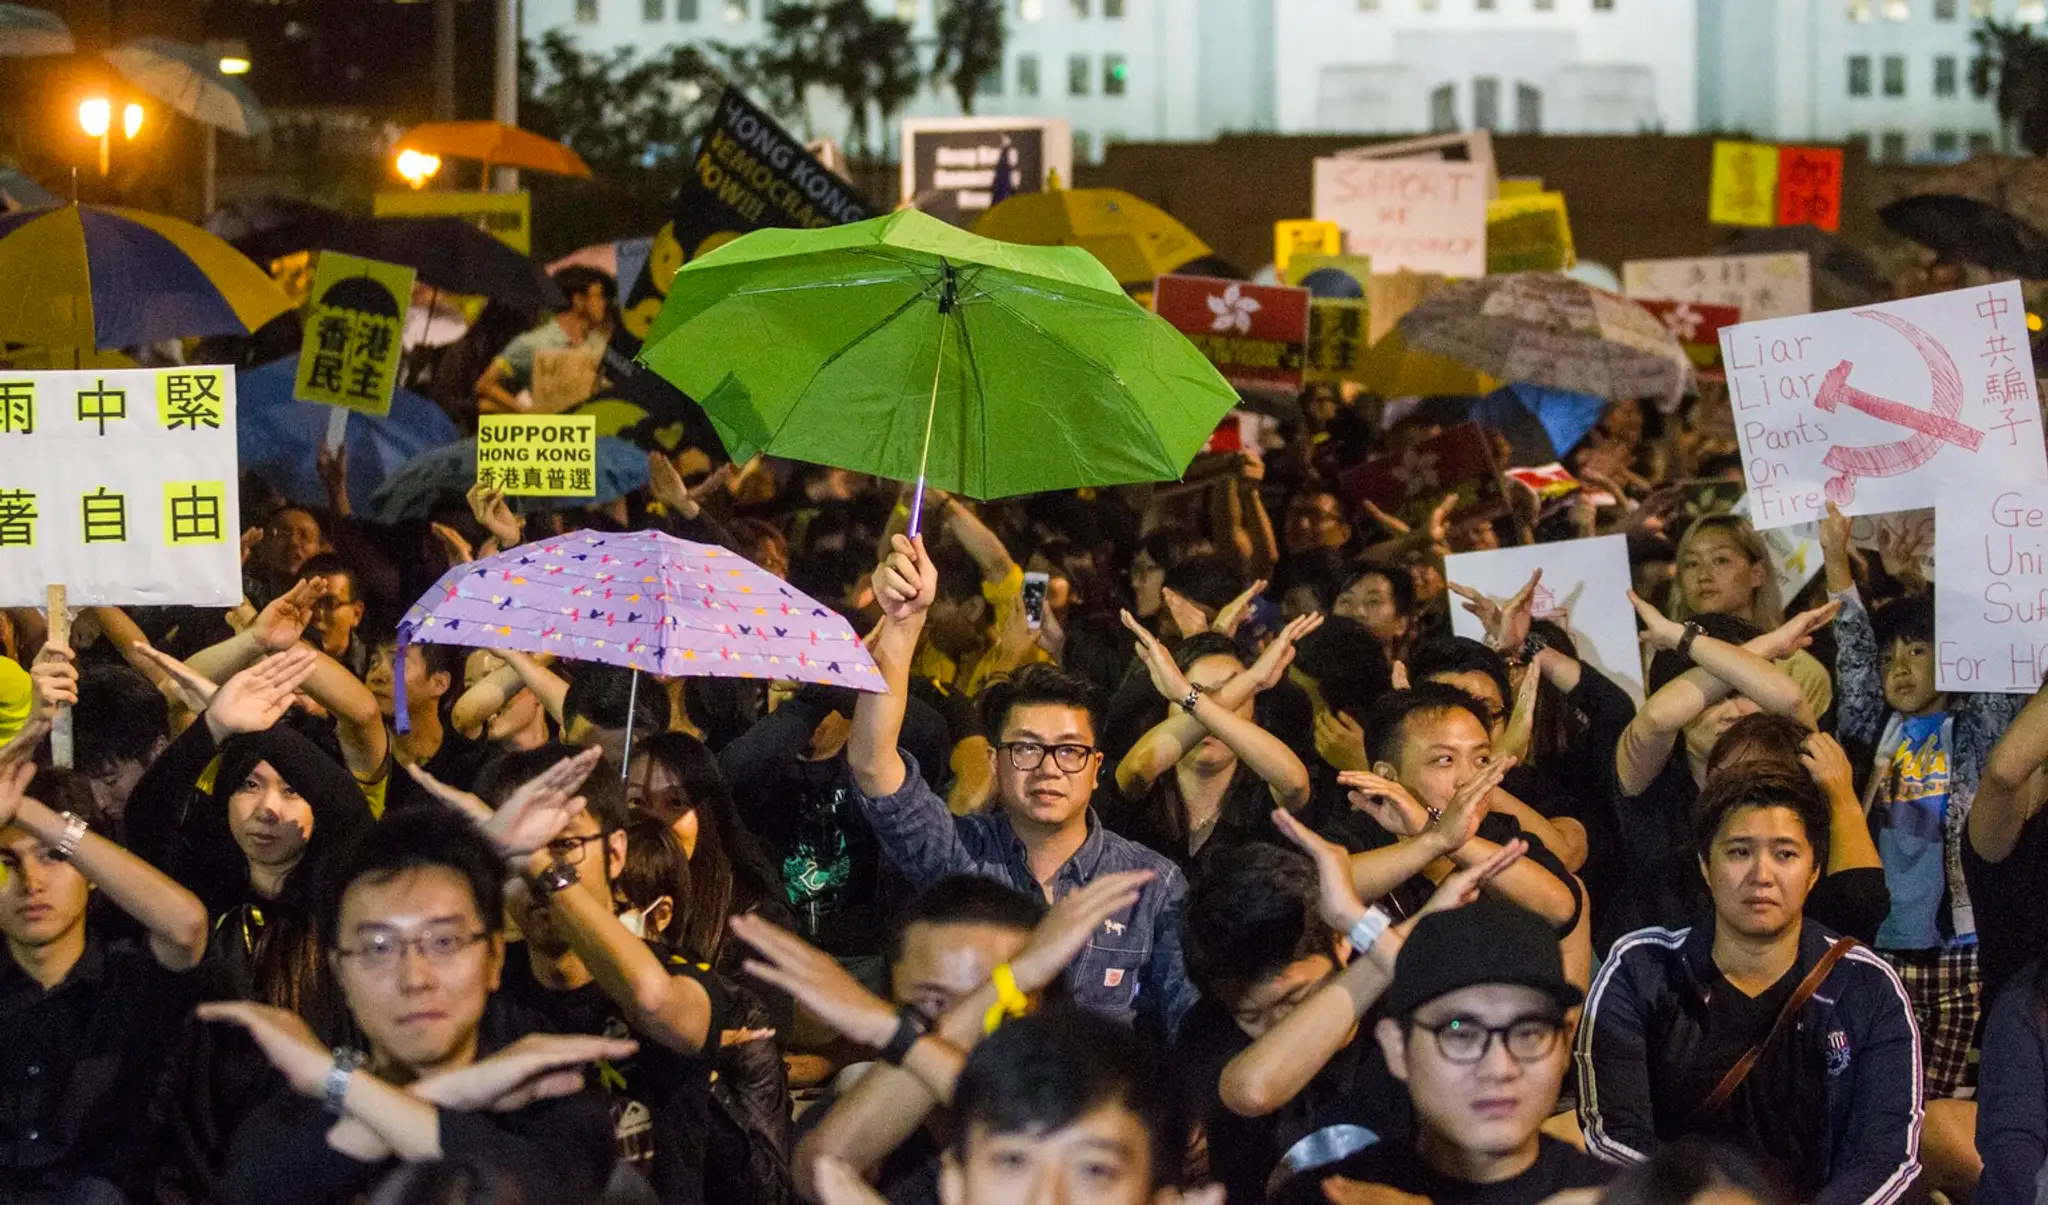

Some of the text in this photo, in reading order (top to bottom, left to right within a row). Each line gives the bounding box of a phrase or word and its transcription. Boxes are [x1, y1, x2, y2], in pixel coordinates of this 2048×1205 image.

[317, 316, 393, 363] 香港
[1728, 332, 1812, 370] Liar
[306, 354, 384, 401] 民主
[1975, 290, 2032, 446] 中共騙子
[1734, 372, 1815, 411] Liar
[479, 425, 592, 444] SUPPORT
[1744, 412, 1829, 456] Pants
[479, 448, 592, 462] HONG KONG
[1749, 457, 1790, 484] On
[479, 465, 592, 491] 香港真普選
[1752, 484, 1821, 520] Fire
[1991, 491, 2045, 528] Ge
[1938, 641, 1987, 685] For
